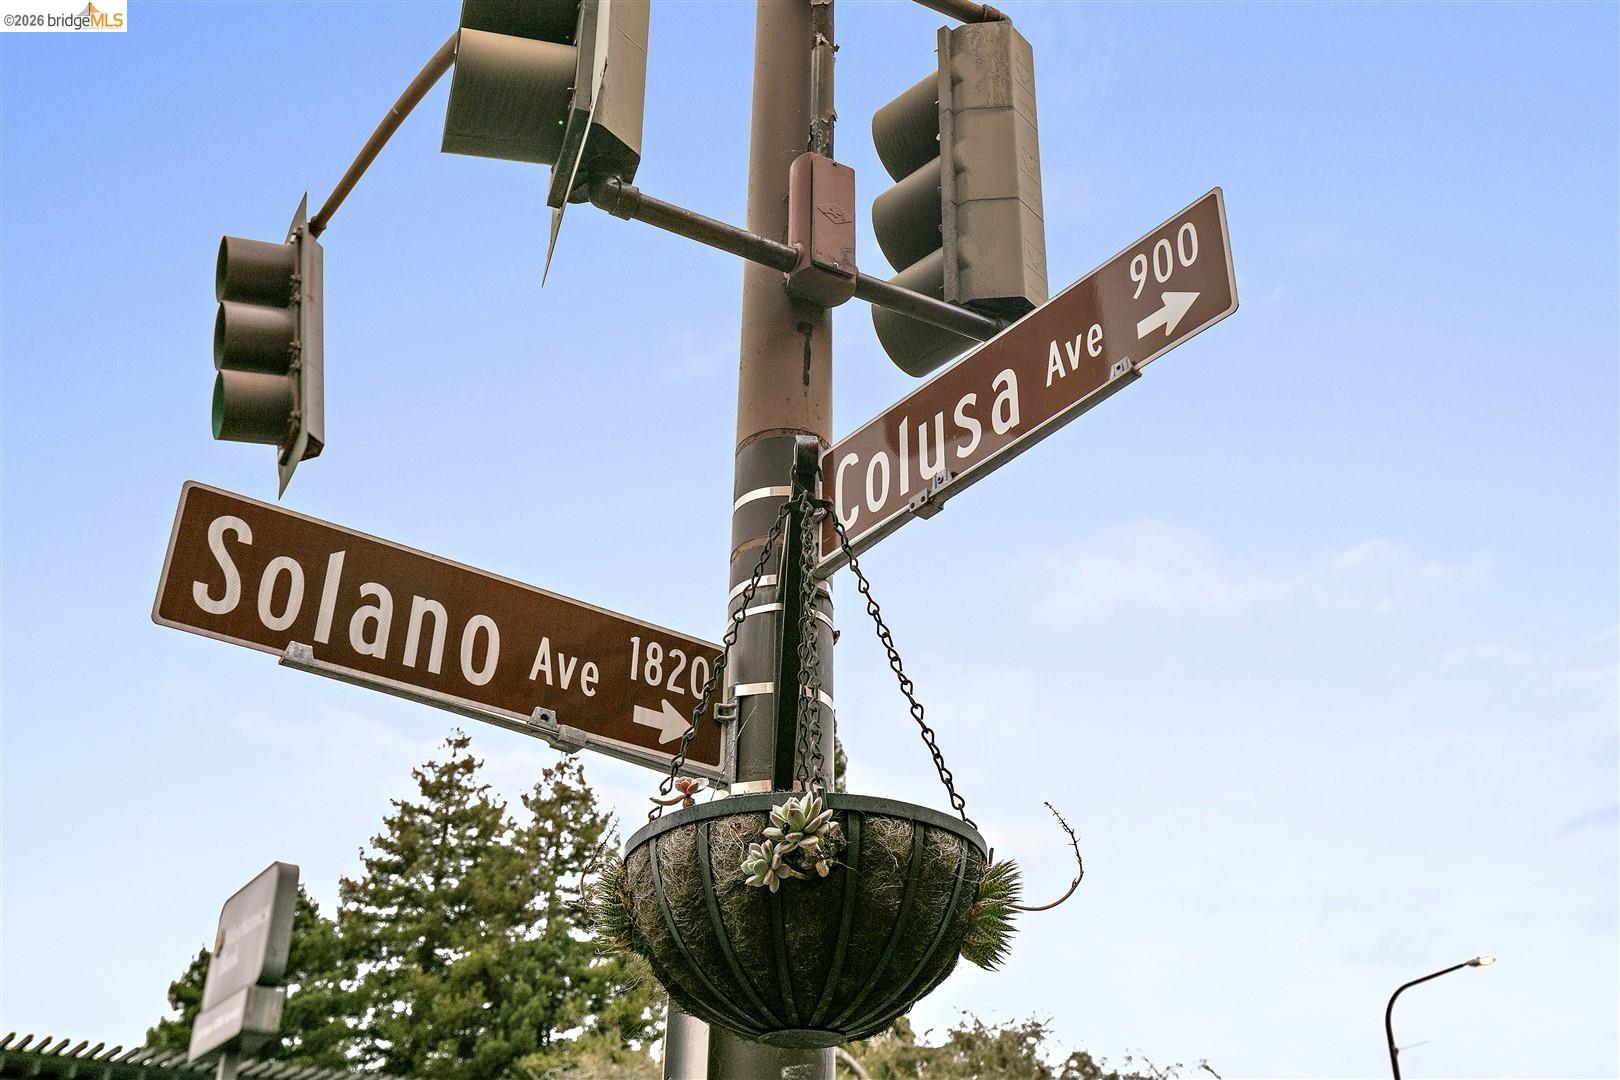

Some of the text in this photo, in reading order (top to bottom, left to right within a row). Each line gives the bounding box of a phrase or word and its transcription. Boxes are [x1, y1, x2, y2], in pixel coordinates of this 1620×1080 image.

[1129, 222, 1199, 300] 900
[835, 323, 1103, 532] Colusa Ave
[192, 515, 599, 697] Solano Ave
[629, 636, 709, 700] 1820
